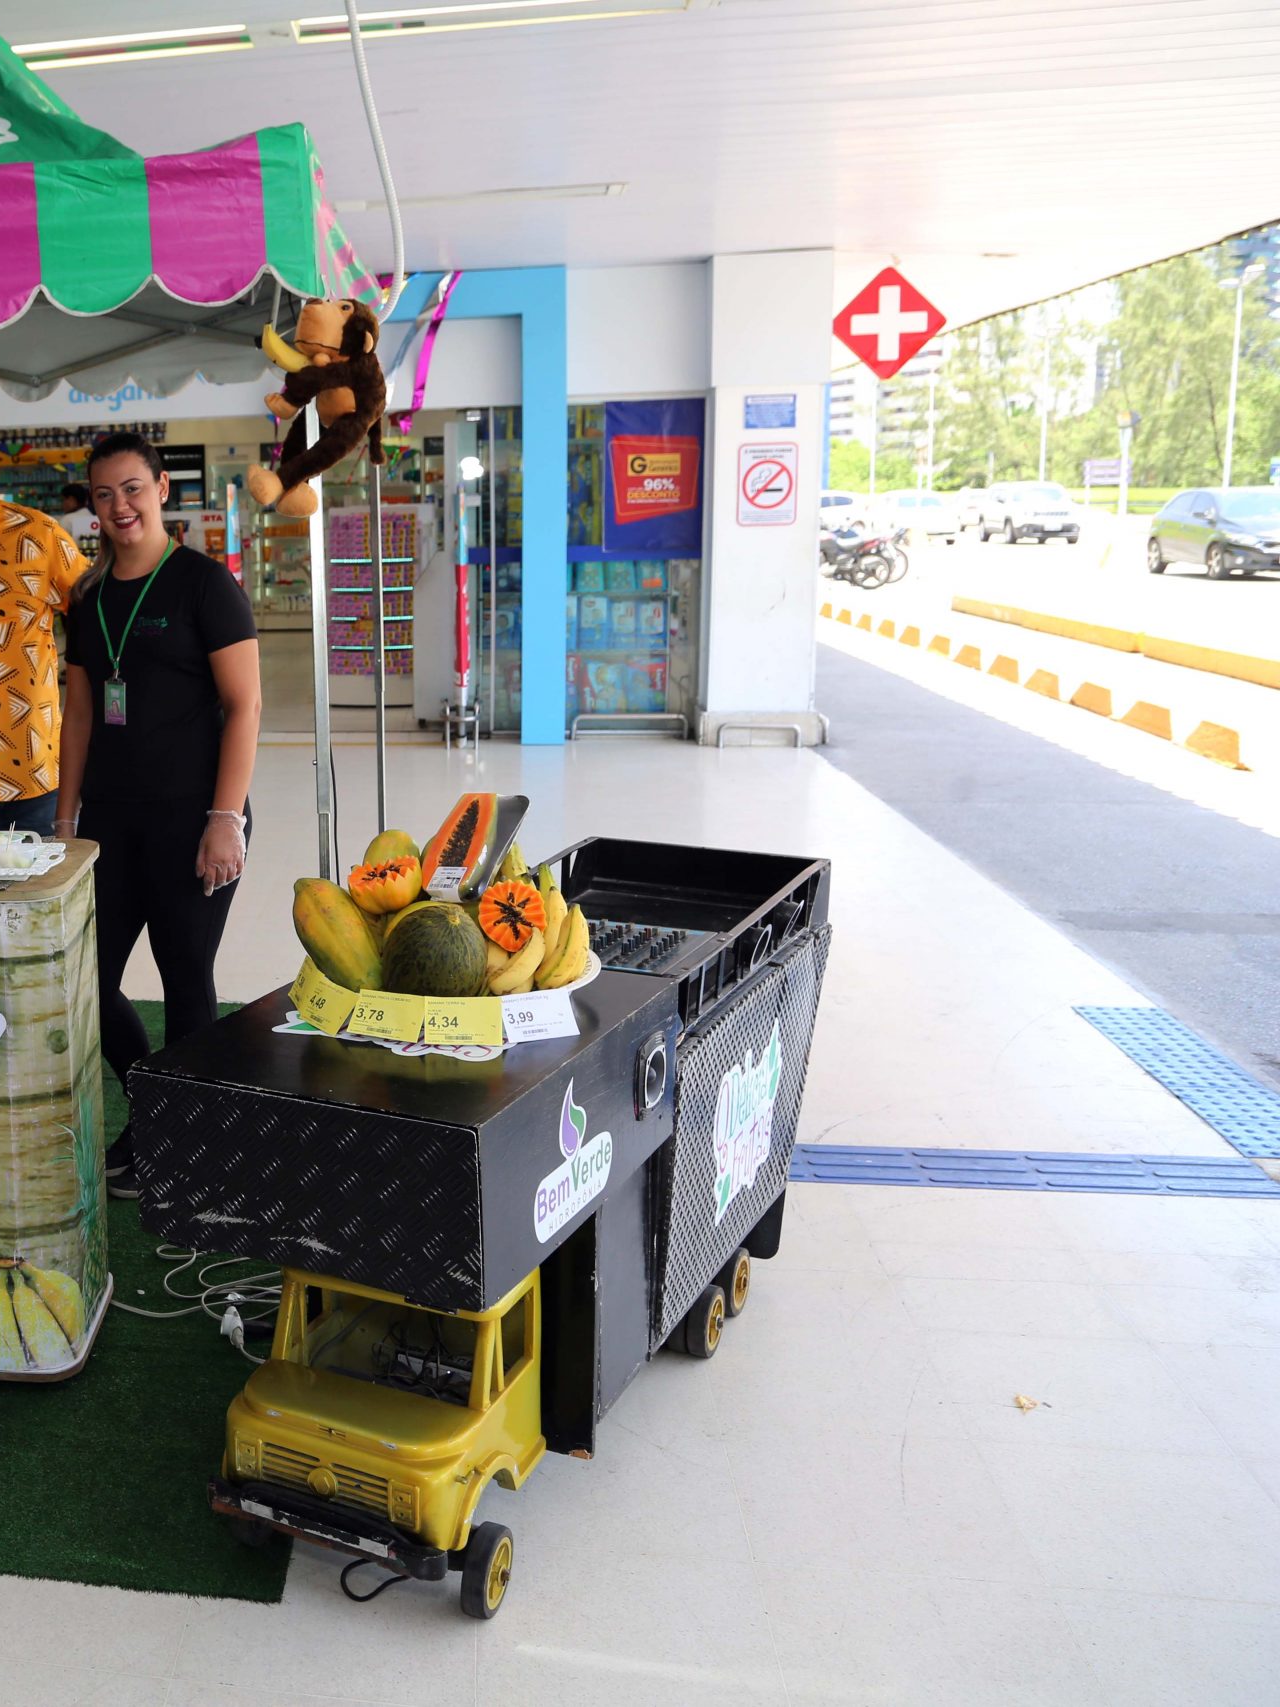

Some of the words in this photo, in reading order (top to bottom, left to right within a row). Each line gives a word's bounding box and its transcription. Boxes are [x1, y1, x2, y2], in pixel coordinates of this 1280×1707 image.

[643, 477, 675, 491] 96%
[355, 1008, 384, 1022] 3,78
[507, 1011, 534, 1025] 3,99
[428, 1016, 459, 1029] 4,34
